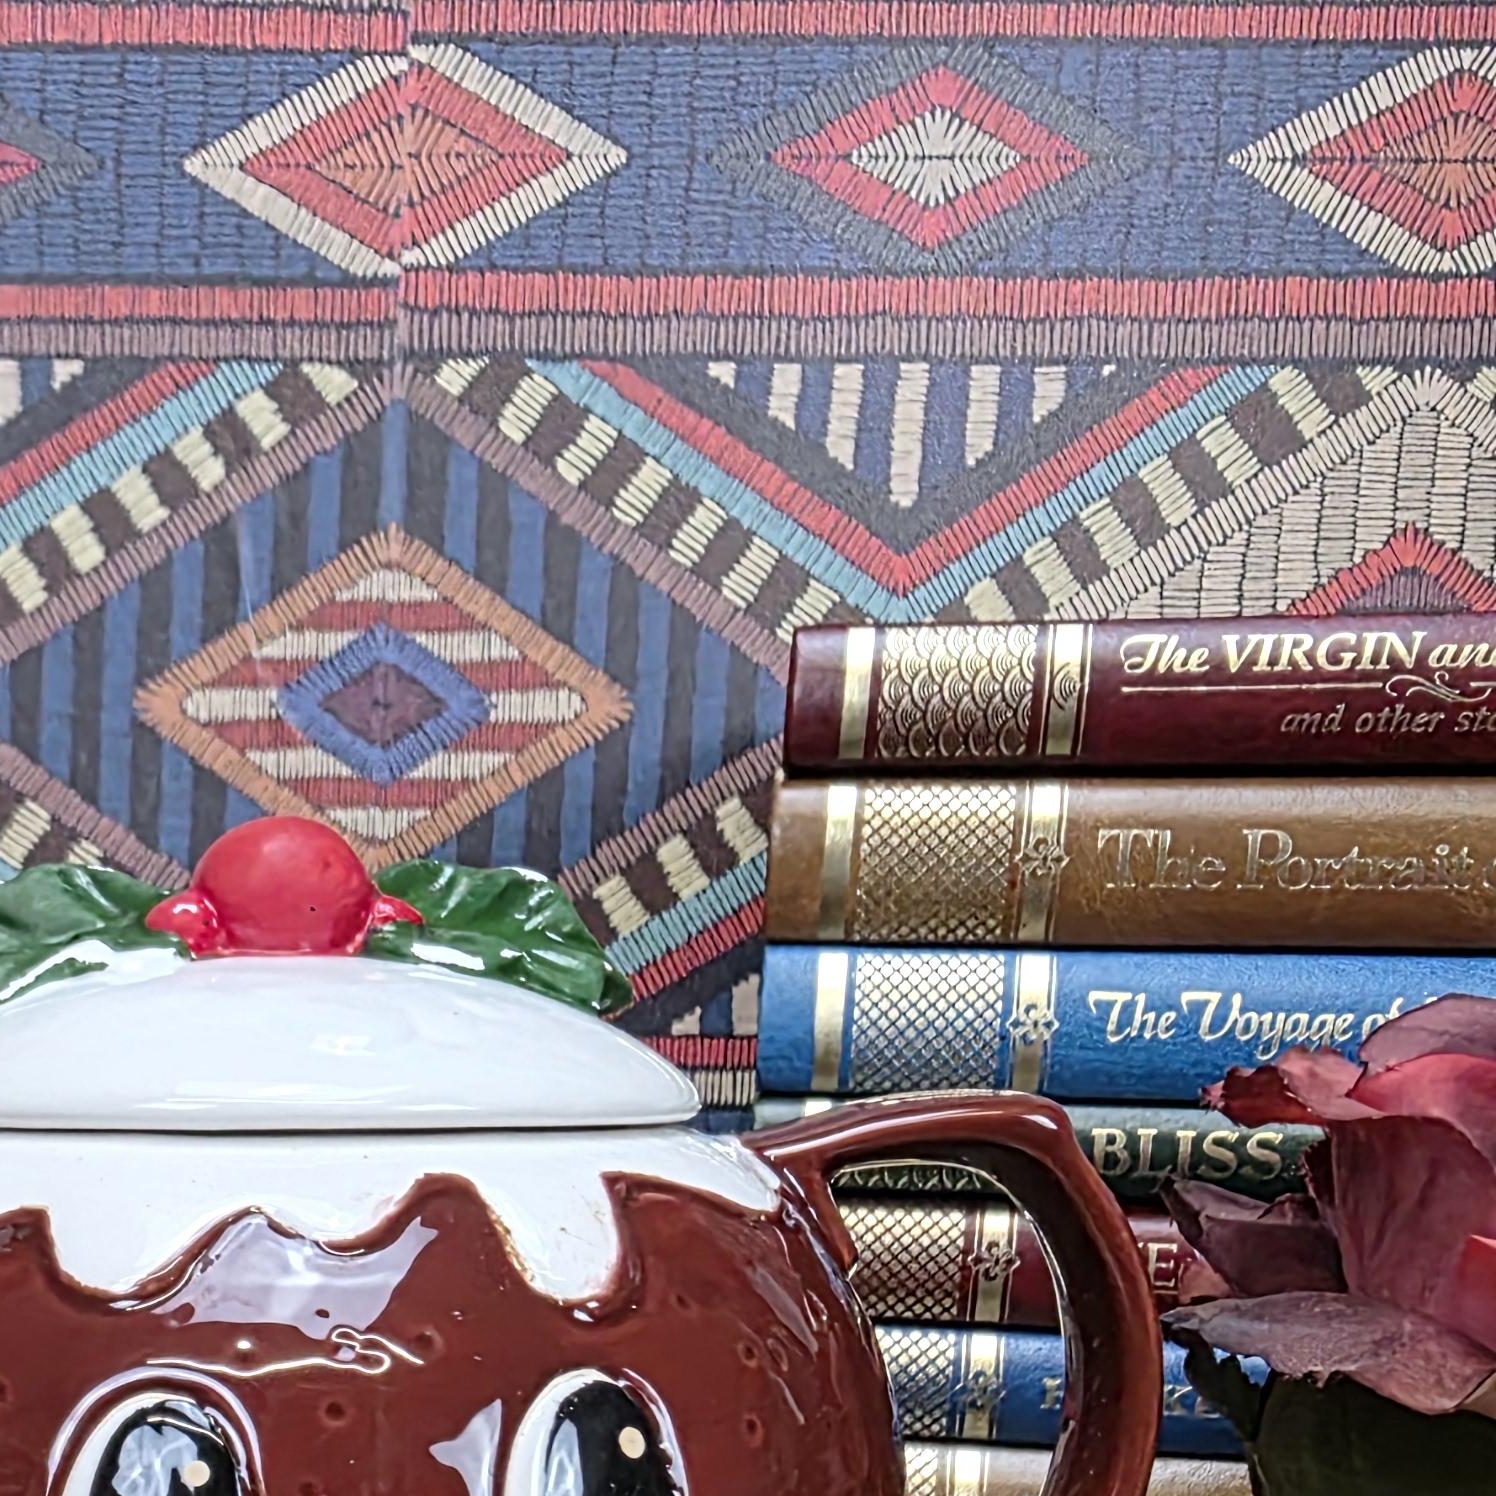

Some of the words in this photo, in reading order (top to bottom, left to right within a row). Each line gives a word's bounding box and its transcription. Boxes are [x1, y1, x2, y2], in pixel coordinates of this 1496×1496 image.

[1119, 630, 1209, 674] The
[1221, 629, 1428, 673] VIRGIN
[1427, 641, 1496, 670] an
[1280, 702, 1342, 735] and
[1354, 702, 1446, 735] other
[1096, 827, 1227, 892] The
[1235, 828, 1475, 892] Portrait
[1087, 989, 1173, 1044] The
[1181, 989, 1355, 1061] Voyage
[1090, 1127, 1285, 1181] BLISS
